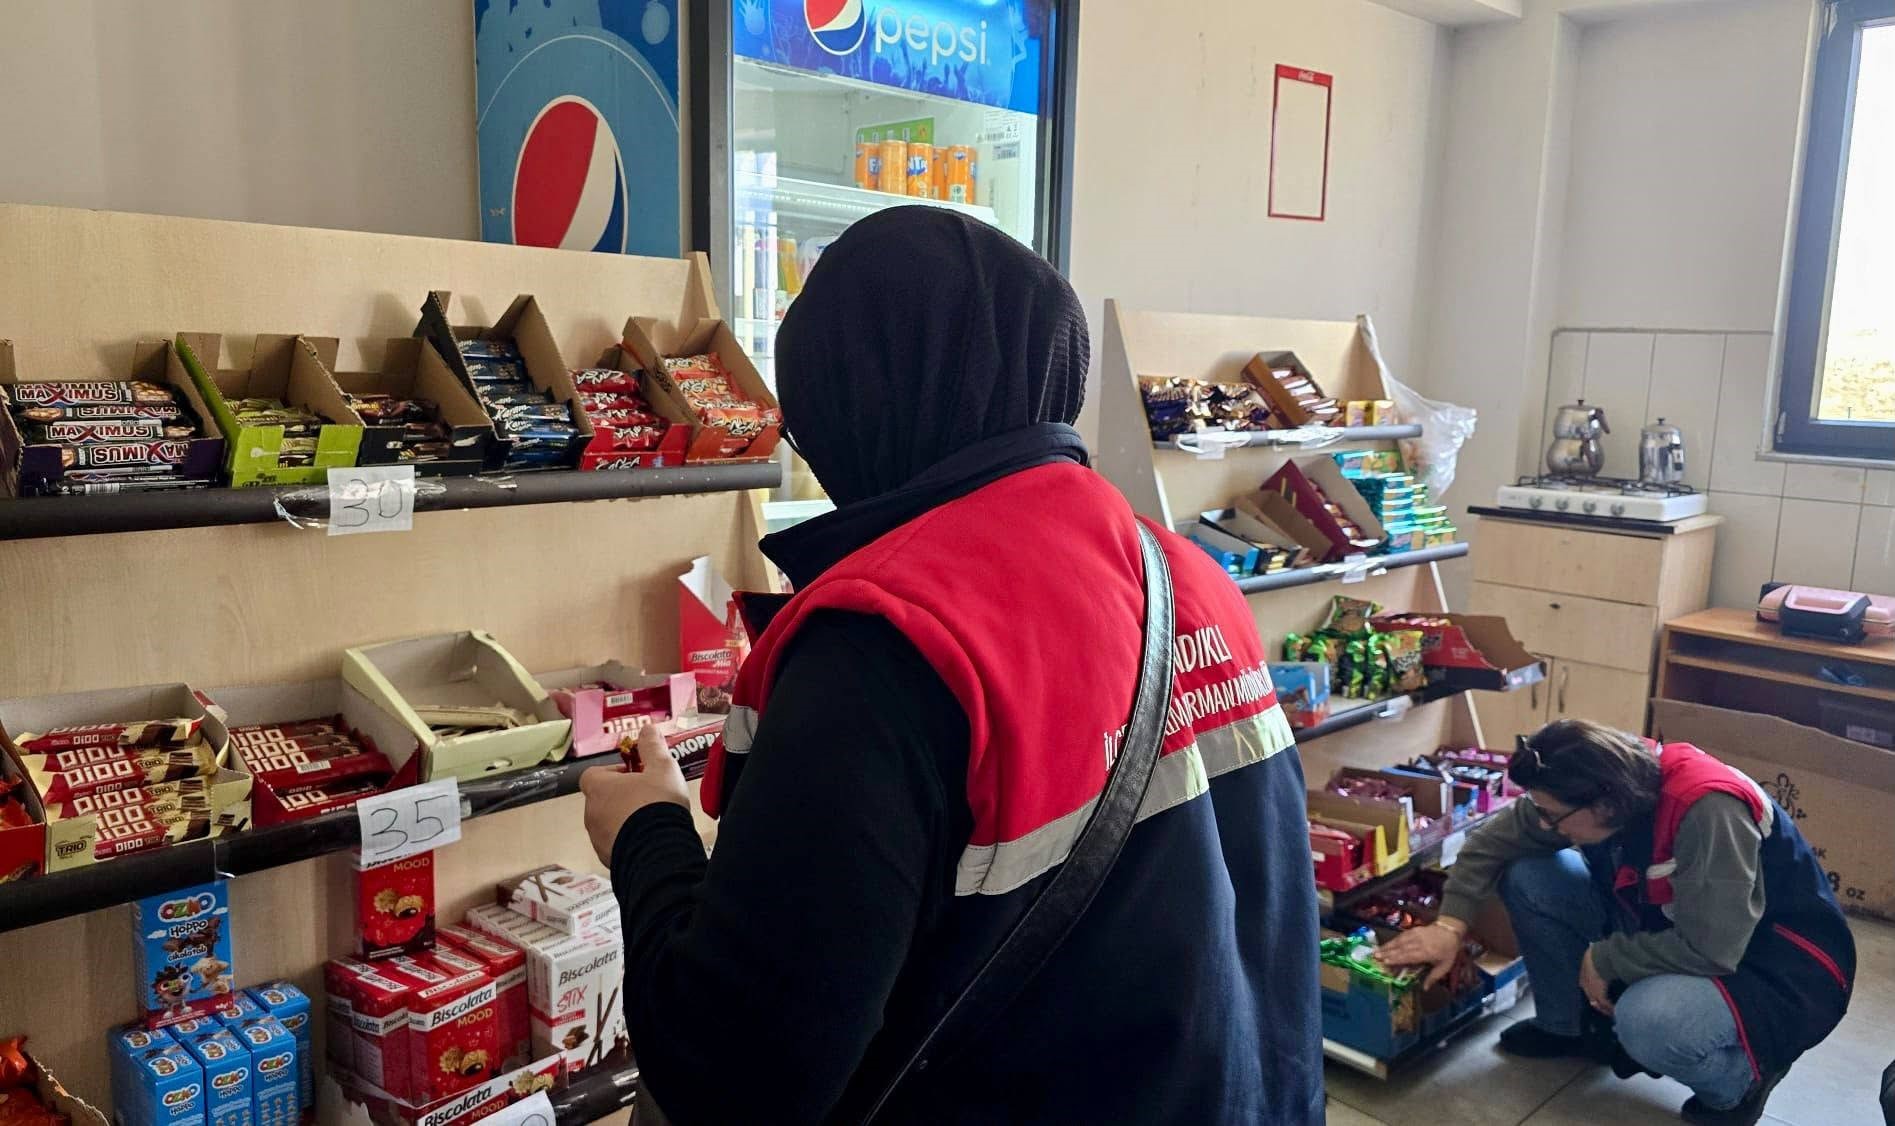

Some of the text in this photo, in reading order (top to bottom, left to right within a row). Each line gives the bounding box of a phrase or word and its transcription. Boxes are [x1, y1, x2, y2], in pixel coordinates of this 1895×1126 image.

[875, 8, 987, 66] pepsi
[21, 386, 118, 404] MAXIMUS
[51, 424, 149, 444] MAXIMUS
[94, 440, 189, 465] MAXIMUS
[337, 479, 403, 528] 30
[370, 795, 449, 855] 35
[394, 857, 430, 873] MOOD
[558, 949, 618, 987] Biscolata
[431, 988, 493, 1028] Biscolata
[557, 985, 589, 1014] STIX
[457, 1007, 493, 1028] MOOD
[424, 1086, 492, 1126] Biscolata
